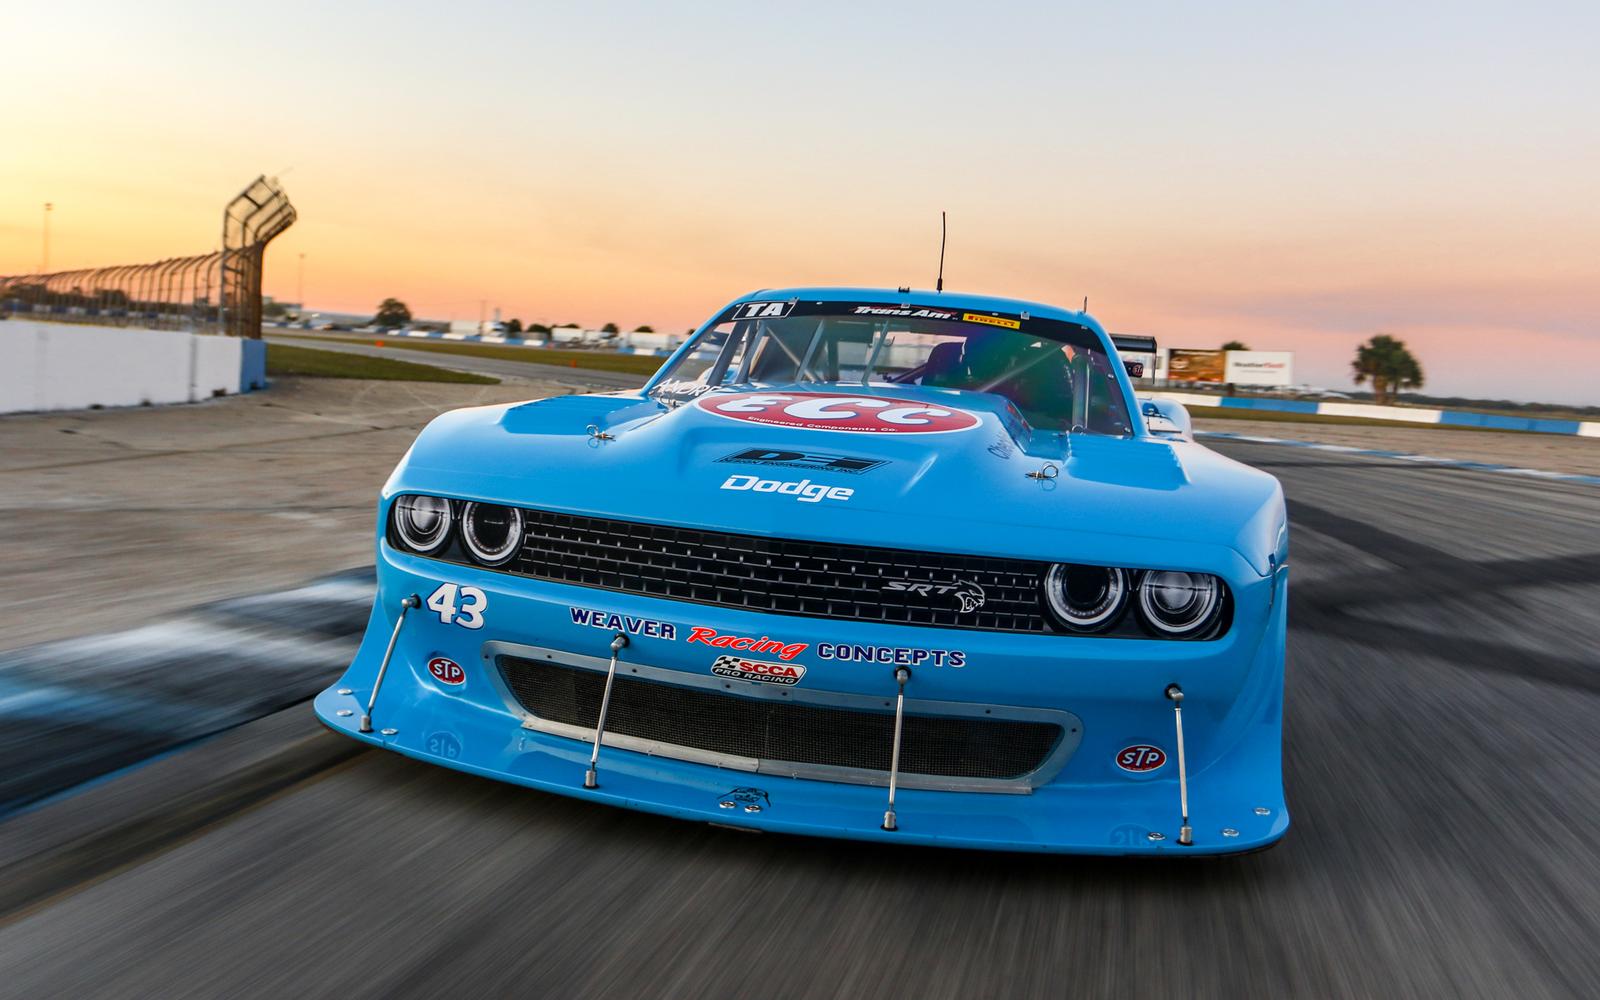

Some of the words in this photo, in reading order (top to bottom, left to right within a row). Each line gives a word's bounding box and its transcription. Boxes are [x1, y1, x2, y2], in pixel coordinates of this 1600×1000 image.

[745, 302, 783, 317] TA
[716, 394, 951, 425] ECC
[747, 416, 803, 428] Engineered
[807, 423, 876, 432] Components
[720, 474, 855, 503] Dodge
[882, 581, 957, 597] SRT
[427, 581, 488, 630] 43
[570, 607, 677, 641] WEAVER
[687, 626, 809, 661] Racing
[817, 642, 966, 667] CONCEPTS
[433, 660, 461, 679] STP
[715, 668, 741, 678] PRO
[743, 672, 795, 685] RACING
[739, 661, 798, 678] SCCA
[1122, 747, 1159, 767] STP
